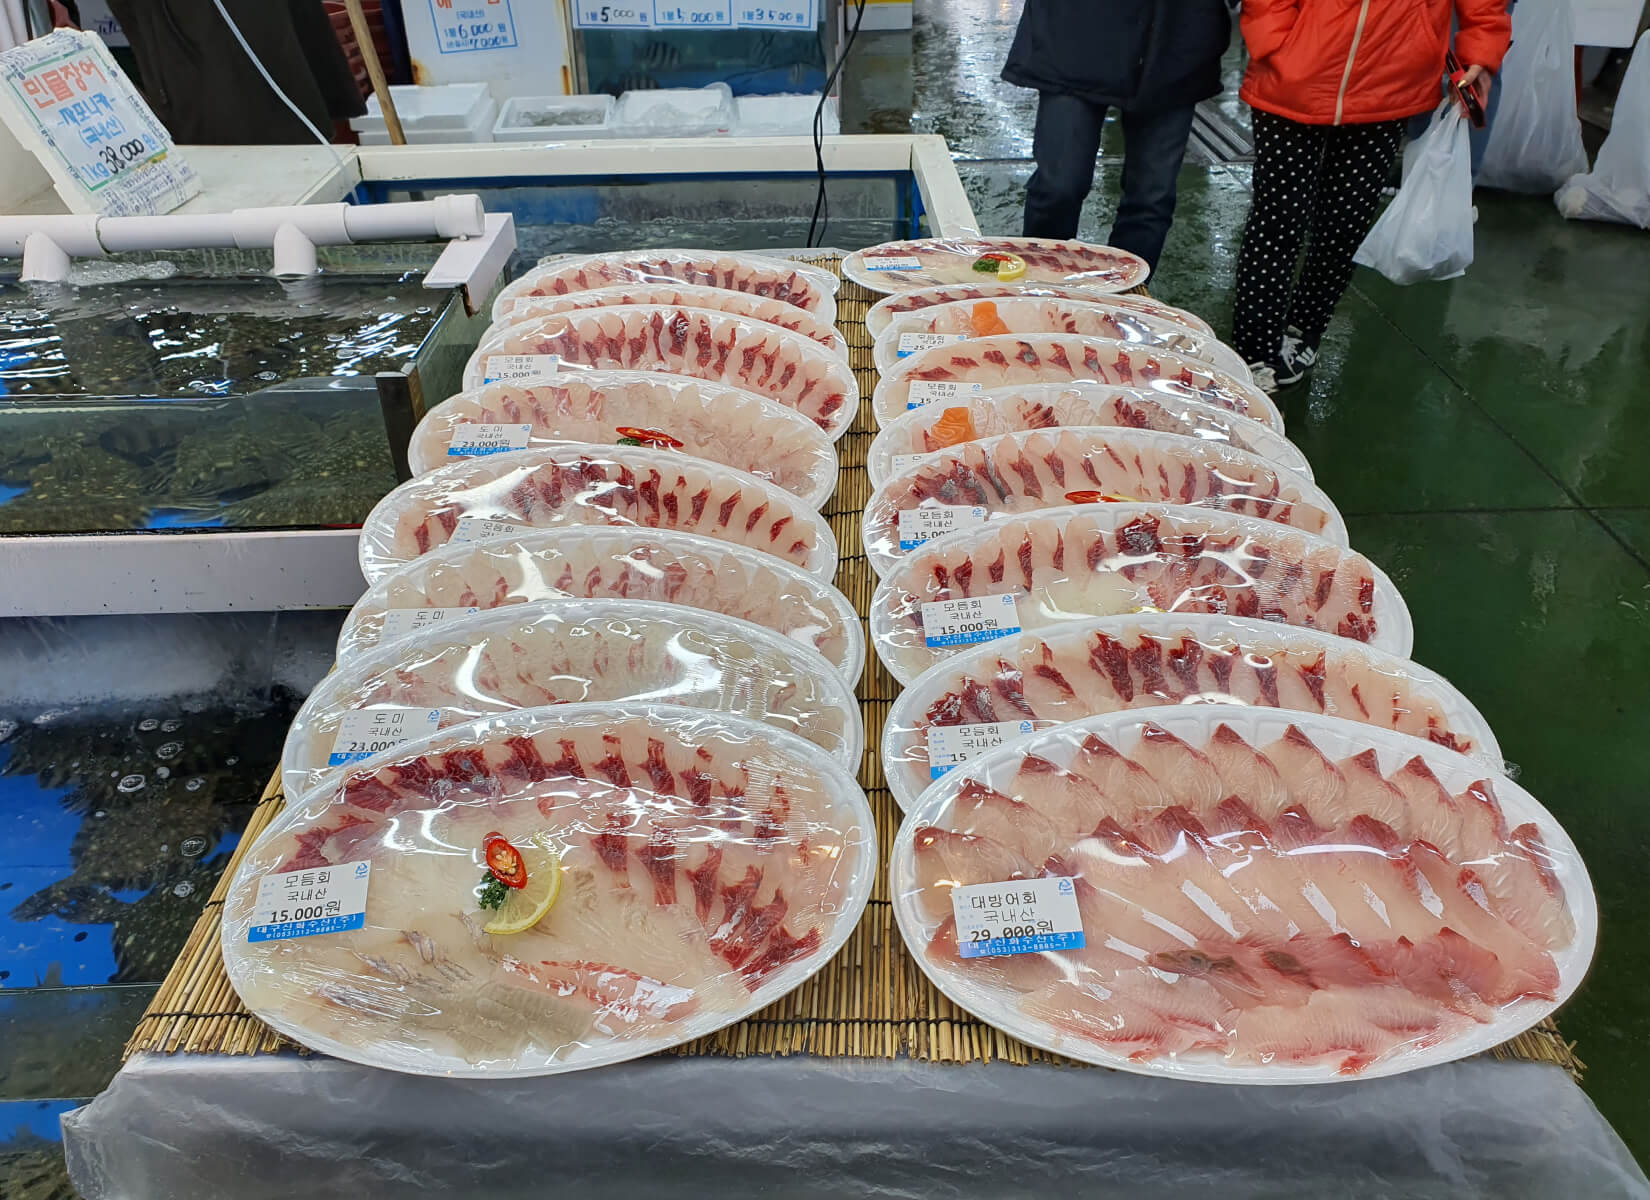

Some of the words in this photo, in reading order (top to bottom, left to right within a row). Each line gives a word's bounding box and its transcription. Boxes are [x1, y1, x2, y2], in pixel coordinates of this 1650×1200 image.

[23, 56, 107, 109] 민물장어
[79, 113, 127, 150] (국내산)
[944, 599, 982, 612] 모듬회
[415, 611, 445, 620] 도미
[950, 611, 983, 621] 국내산
[373, 713, 405, 724] 도미
[368, 727, 403, 737] 국내산
[959, 725, 999, 737] 모듬회
[962, 737, 1004, 748] 국내산
[283, 871, 332, 889] 모듬회
[287, 887, 328, 902] 국내산
[971, 890, 1037, 909] 대방어회
[983, 906, 1036, 924] 국내산
